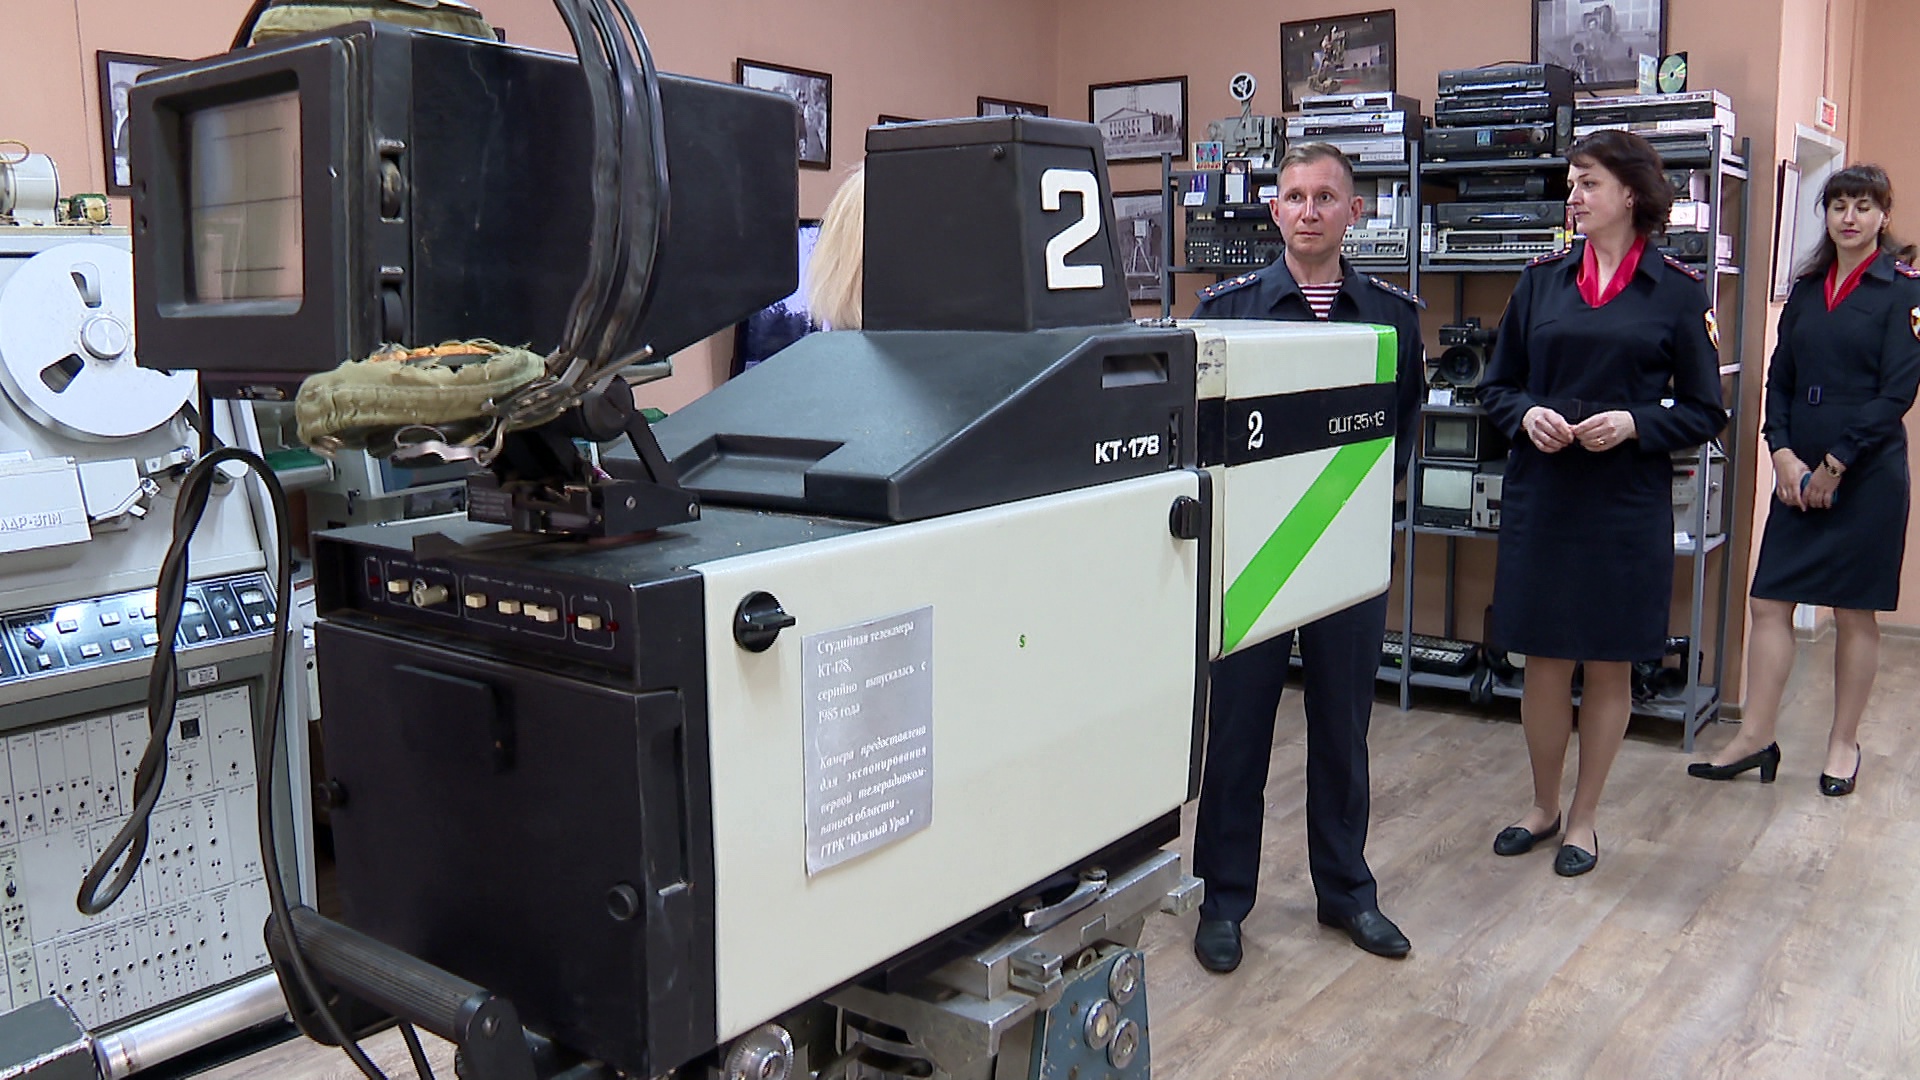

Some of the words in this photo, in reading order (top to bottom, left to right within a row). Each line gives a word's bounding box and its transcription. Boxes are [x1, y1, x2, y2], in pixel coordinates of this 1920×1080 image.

[1040, 168, 1104, 288] 2
[1248, 410, 1264, 450] 2
[817, 634, 869, 655] Студийная
[817, 683, 858, 702] серийно
[921, 661, 927, 671] с
[840, 703, 861, 718] года
[820, 750, 854, 770] Камера
[860, 725, 926, 758] предоставлена
[819, 776, 838, 792] для
[847, 746, 927, 782] экспонирования
[820, 791, 852, 814] первой
[855, 799, 895, 822] области
[820, 837, 845, 859] ГТРК
